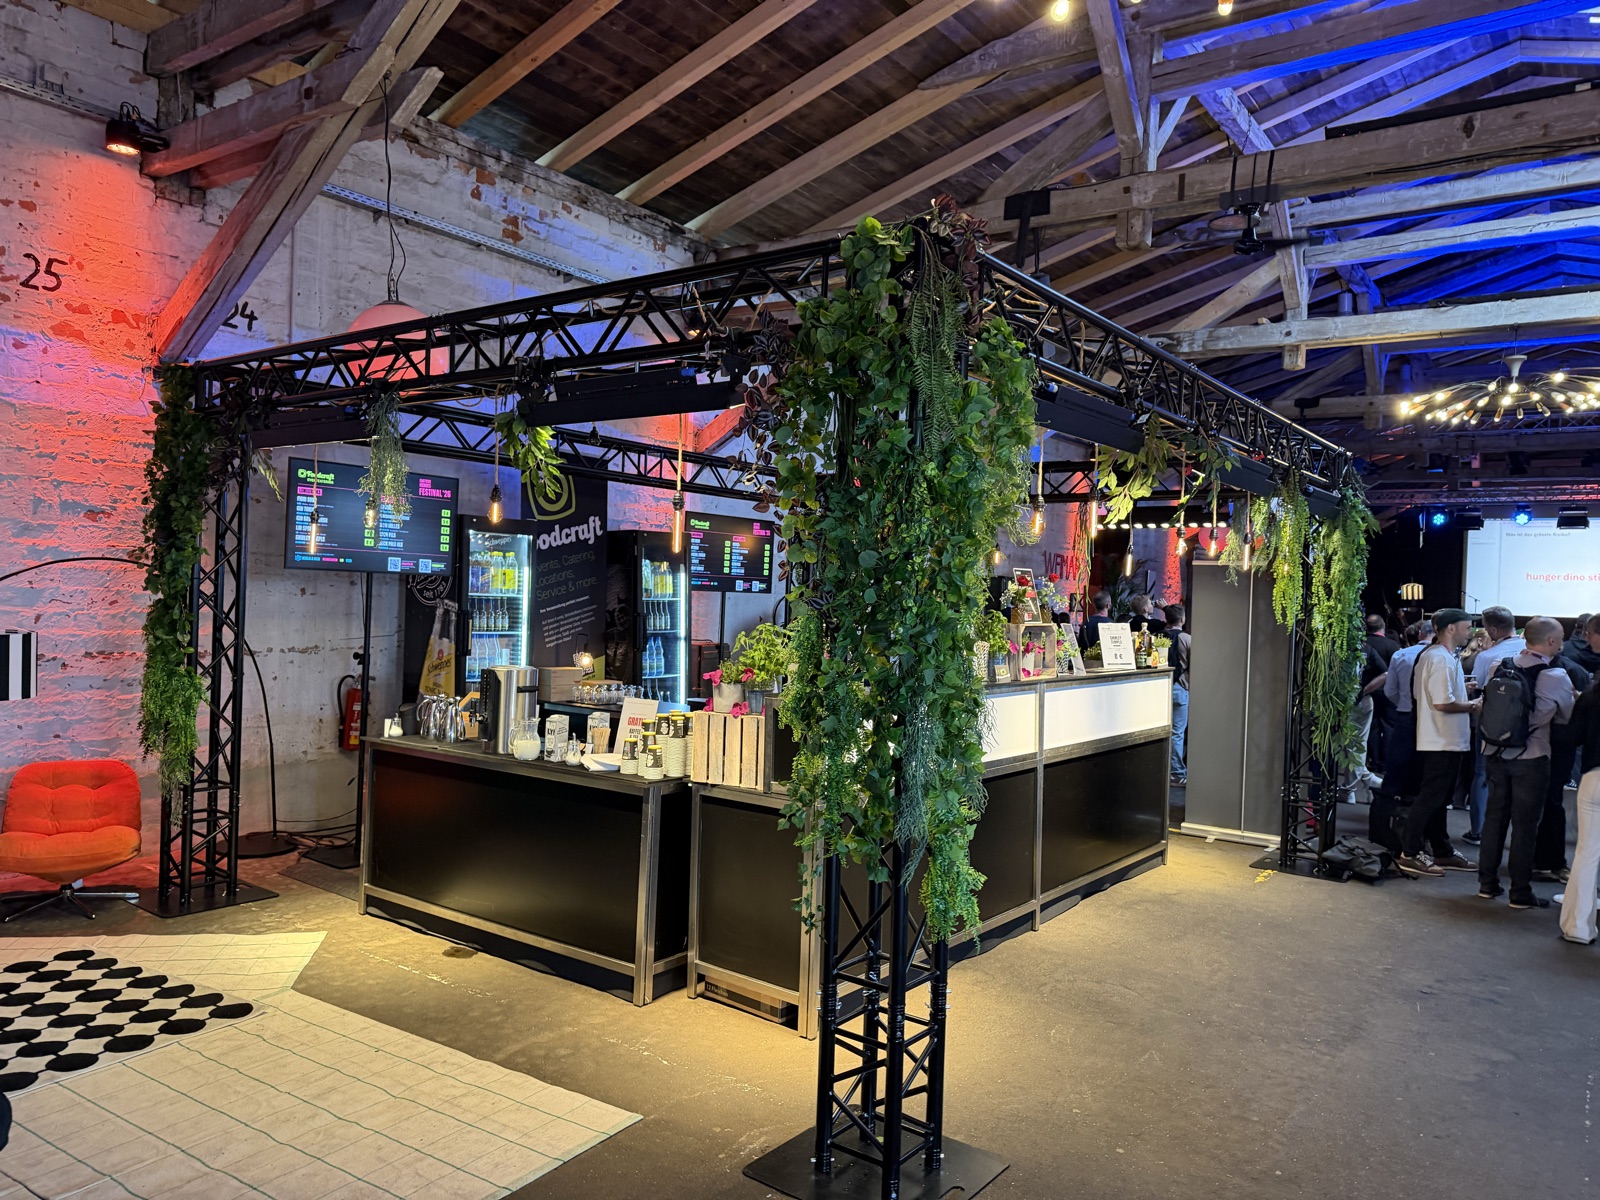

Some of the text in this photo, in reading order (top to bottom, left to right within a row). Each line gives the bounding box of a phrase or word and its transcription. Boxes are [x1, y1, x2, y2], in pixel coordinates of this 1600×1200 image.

[19, 252, 68, 292] 25
[222, 301, 258, 331] 24
[419, 487, 443, 498] FESTIVAL
[536, 516, 603, 550] odcraft
[1526, 572, 1561, 583] hunger
[1563, 573, 1585, 581] dino
[536, 584, 567, 601] Service
[568, 581, 575, 591] &
[428, 658, 452, 674] Schweppes
[627, 716, 647, 726] GRATI
